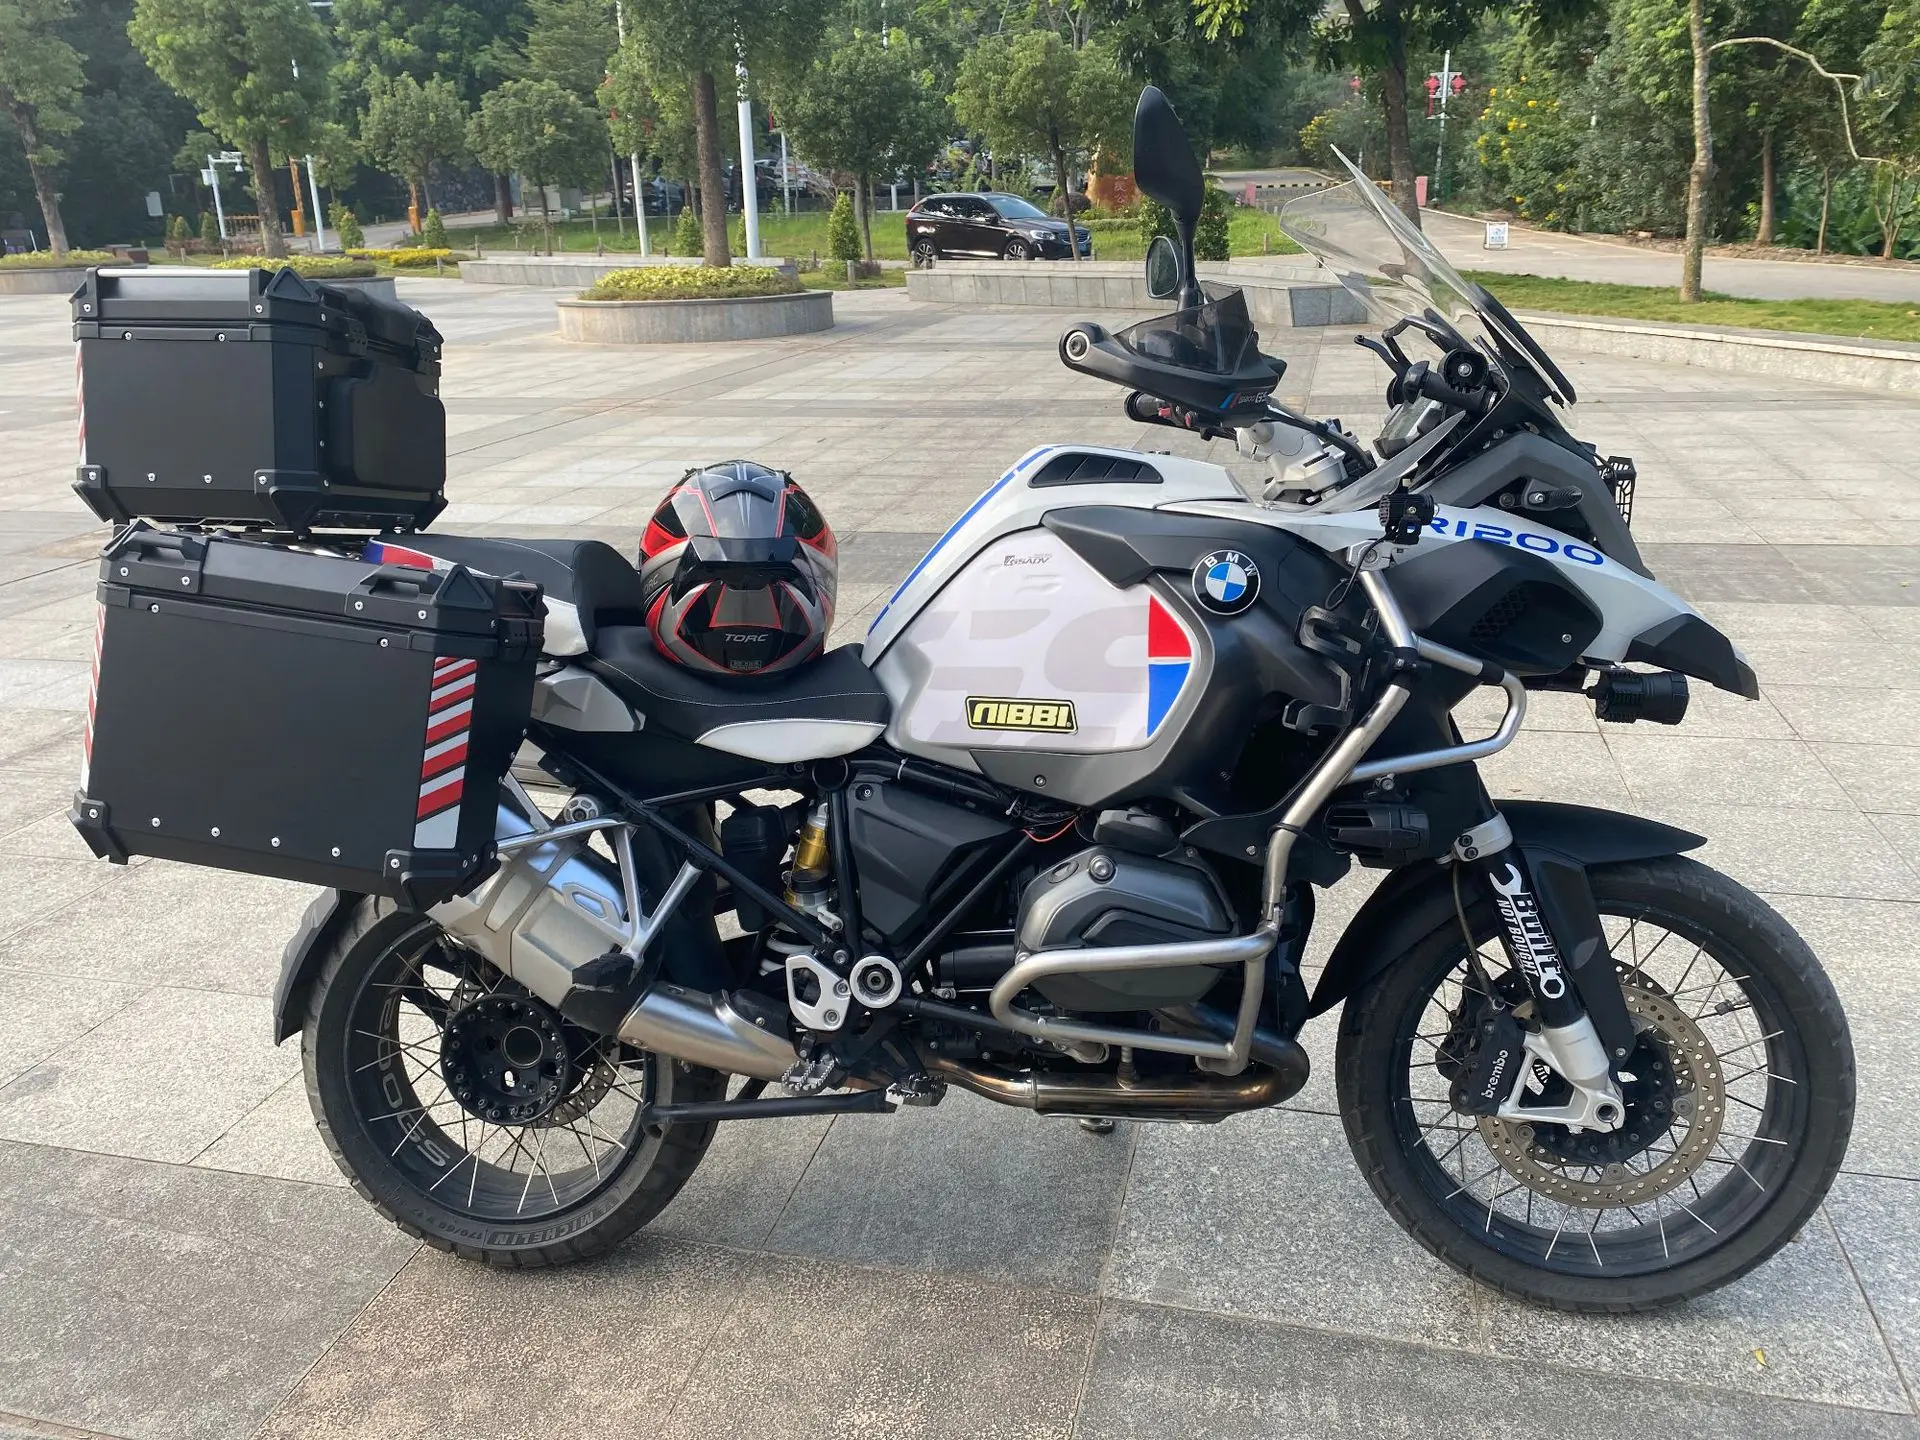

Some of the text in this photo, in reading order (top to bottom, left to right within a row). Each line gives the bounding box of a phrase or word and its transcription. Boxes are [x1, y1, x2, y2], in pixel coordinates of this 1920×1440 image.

[1430, 516, 1604, 566] R1200
[1203, 552, 1258, 577] BMW
[725, 633, 769, 643] TORC
[972, 703, 1070, 728] NIBBI
[1496, 898, 1519, 925] NOT
[1507, 924, 1540, 977] BOUGHT
[1480, 1049, 1509, 1099] brembo
[498, 1211, 595, 1246] MICHELIN
